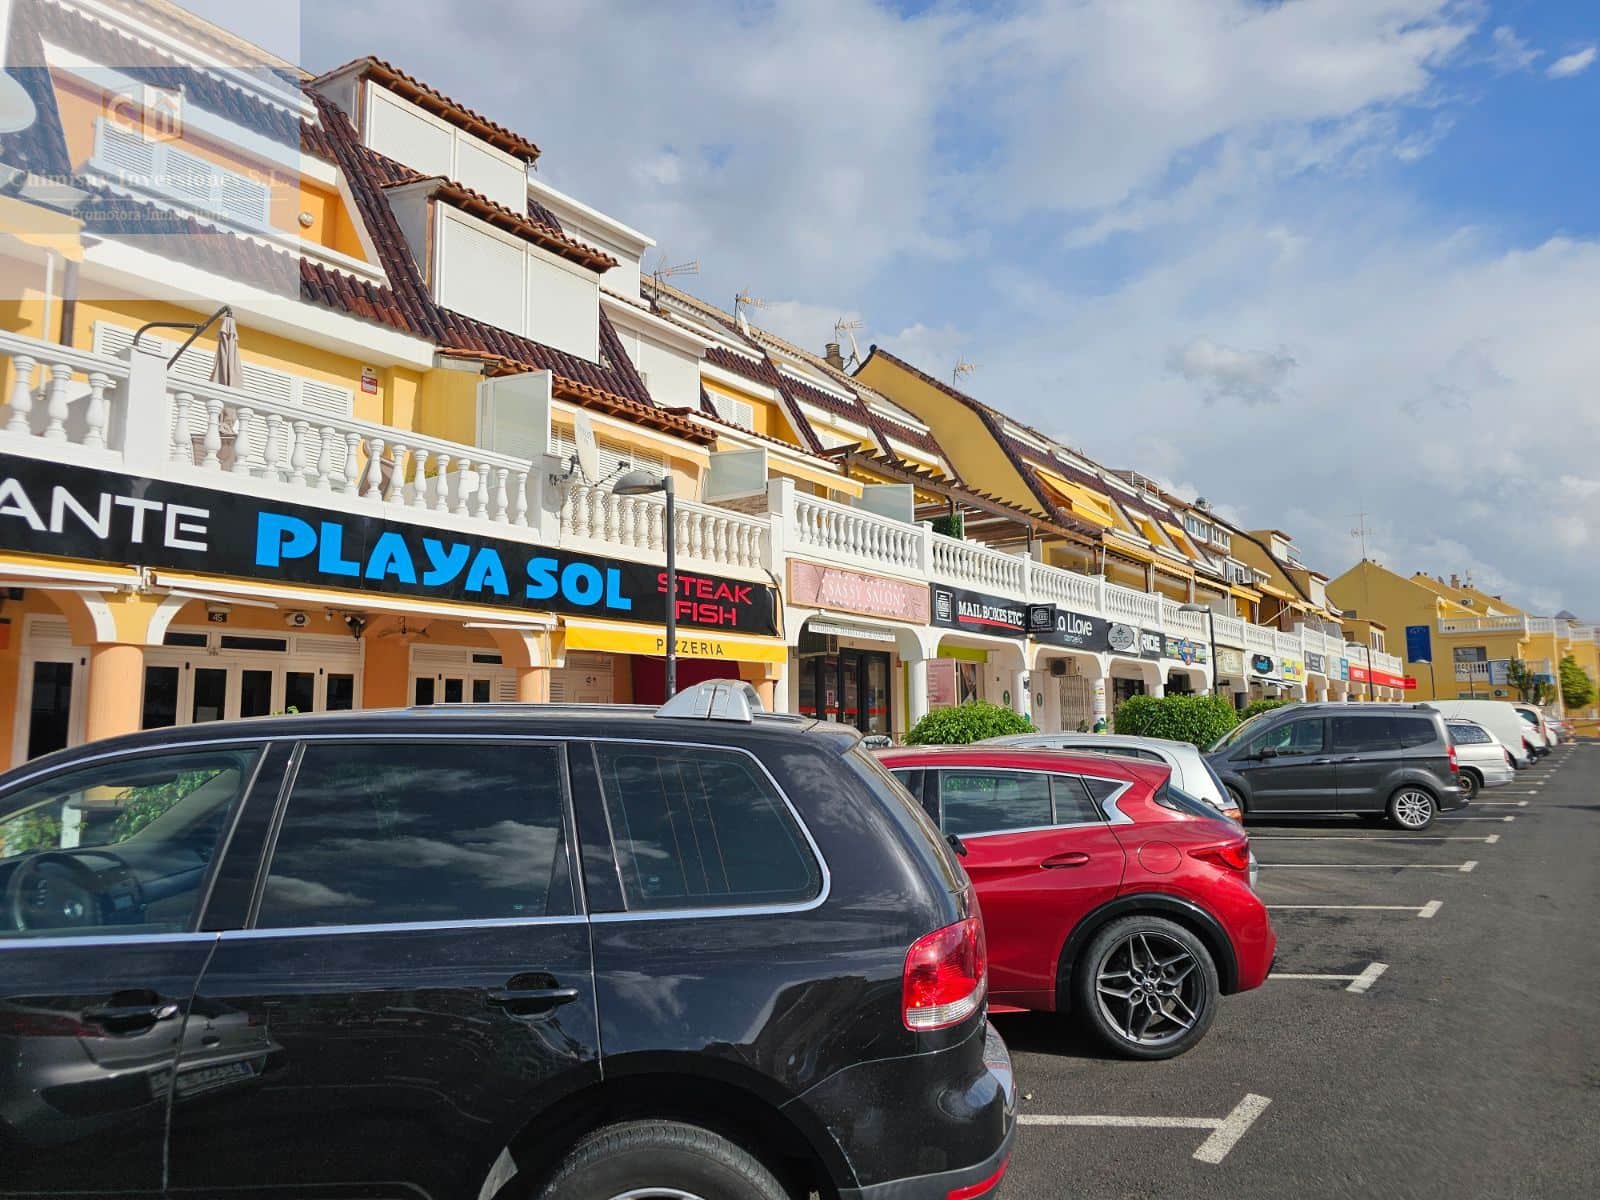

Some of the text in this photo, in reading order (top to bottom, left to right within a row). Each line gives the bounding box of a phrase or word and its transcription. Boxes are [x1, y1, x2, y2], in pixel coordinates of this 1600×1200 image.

[255, 511, 509, 596] PLAYA
[526, 556, 632, 611] SOL
[657, 572, 752, 605] STEAK
[675, 600, 737, 626] FISH
[958, 600, 982, 618] MAIL
[982, 605, 1007, 623] BOXES
[1067, 612, 1093, 636] Llave
[656, 638, 724, 656] PZZERIA
